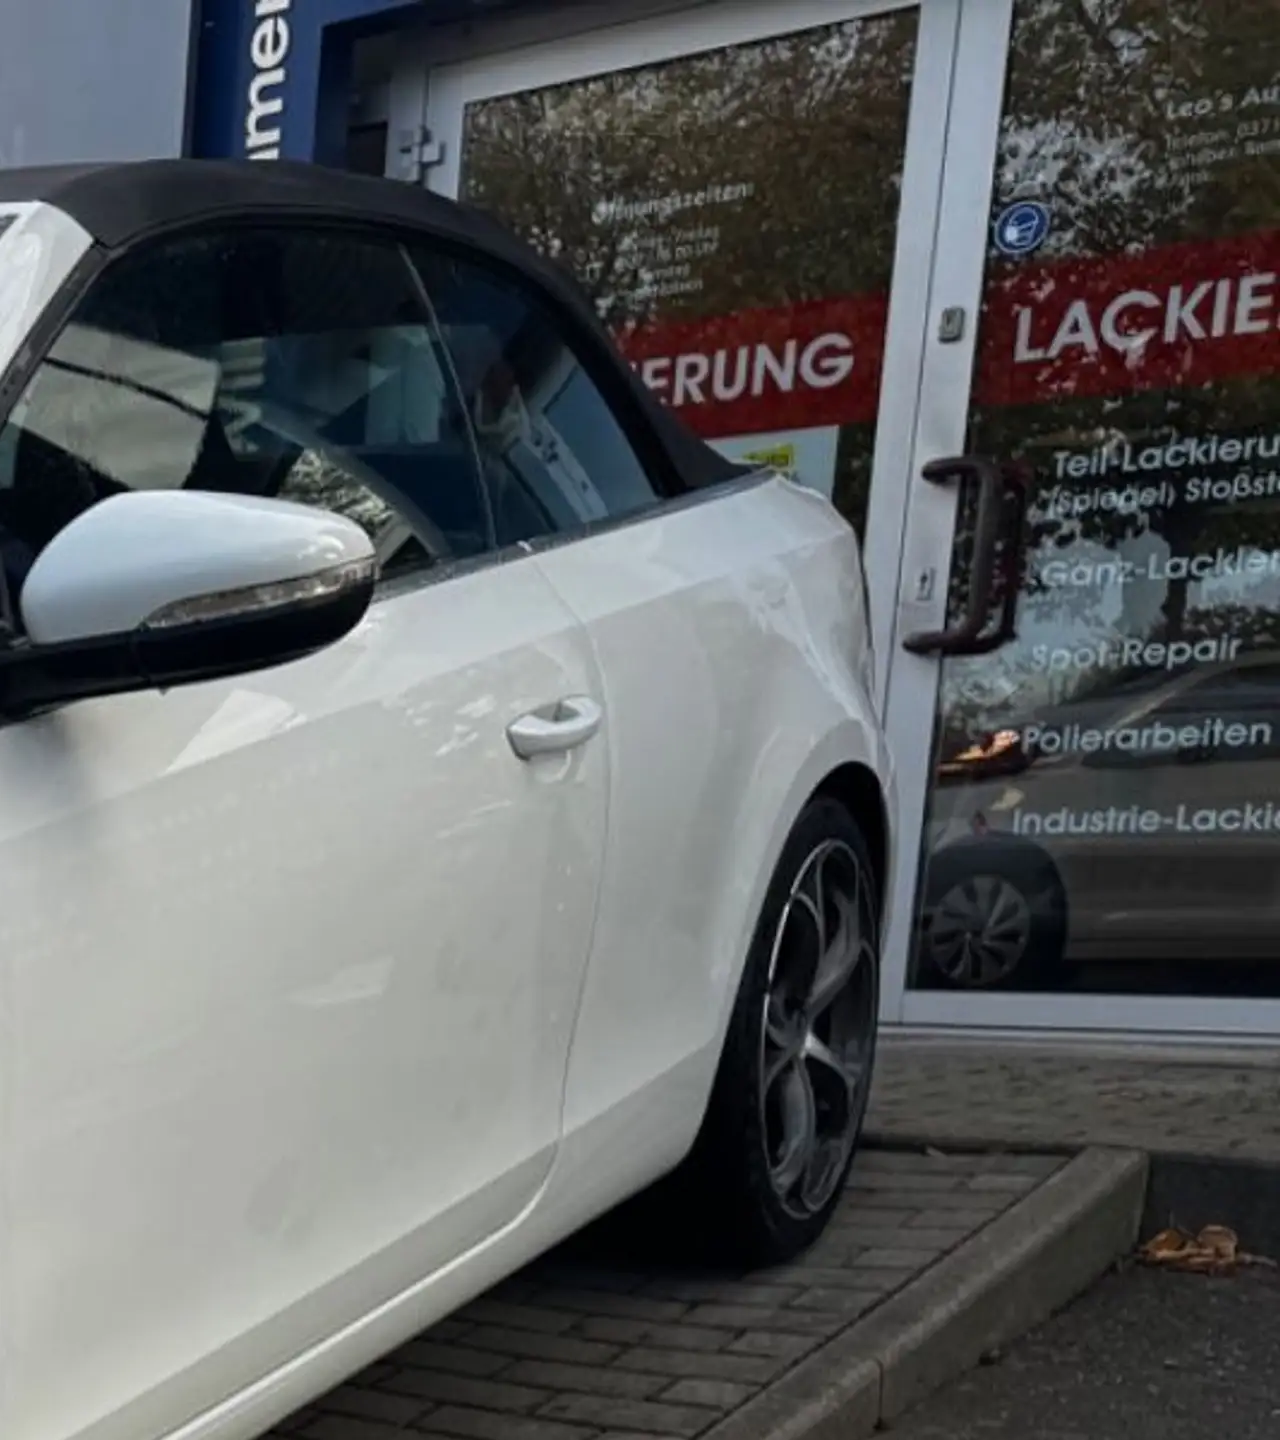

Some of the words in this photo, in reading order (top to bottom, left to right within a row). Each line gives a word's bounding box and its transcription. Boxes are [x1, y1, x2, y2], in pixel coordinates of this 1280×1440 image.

[1013, 271, 1280, 363] LACKIE
[630, 332, 854, 407] ERUNG
[1047, 481, 1177, 516] (Spiegel)
[1184, 469, 1280, 503] Stoßst
[1030, 632, 1241, 671] Spot-Repair
[1022, 718, 1272, 755] Polierarbeiten
